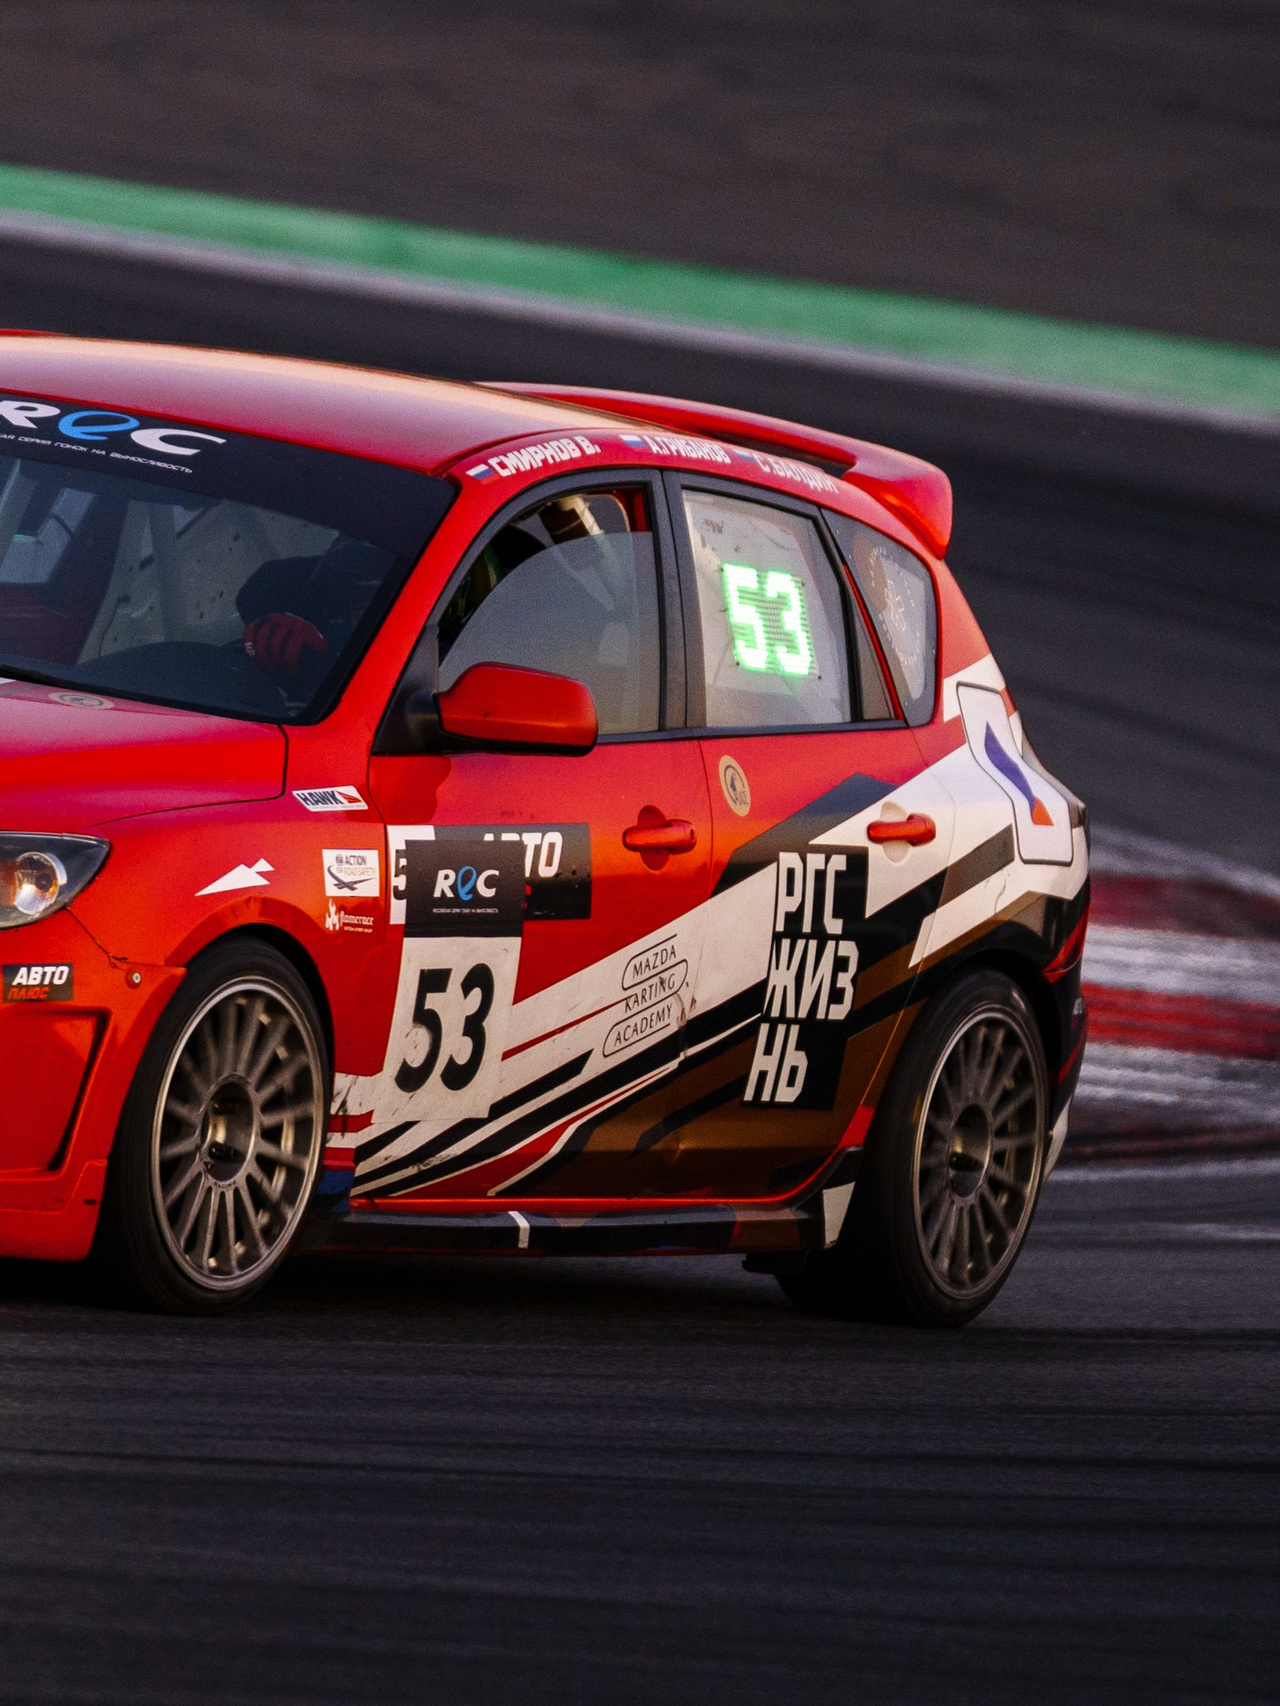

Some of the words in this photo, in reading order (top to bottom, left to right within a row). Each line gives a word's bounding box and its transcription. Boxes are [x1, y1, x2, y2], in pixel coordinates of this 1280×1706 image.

[18, 436, 52, 446] СЕРИЯ
[54, 441, 89, 453] ГОНОК
[110, 452, 193, 474] ВЫНОСЛИВОСТЬ
[488, 438, 581, 476] СМИРНОВ
[576, 435, 602, 454] В.
[722, 563, 813, 677] 53
[296, 790, 344, 806] HAWK
[345, 855, 367, 866] ACTION
[775, 851, 848, 934] РГС
[11, 965, 70, 986] АВТО
[632, 944, 677, 979] MAZDA
[764, 938, 860, 1021] ЖИЗ
[624, 973, 675, 1014] KARTING
[394, 962, 495, 1093] 53
[614, 1003, 673, 1047] ACADEMY
[743, 1023, 809, 1103] НЬ
